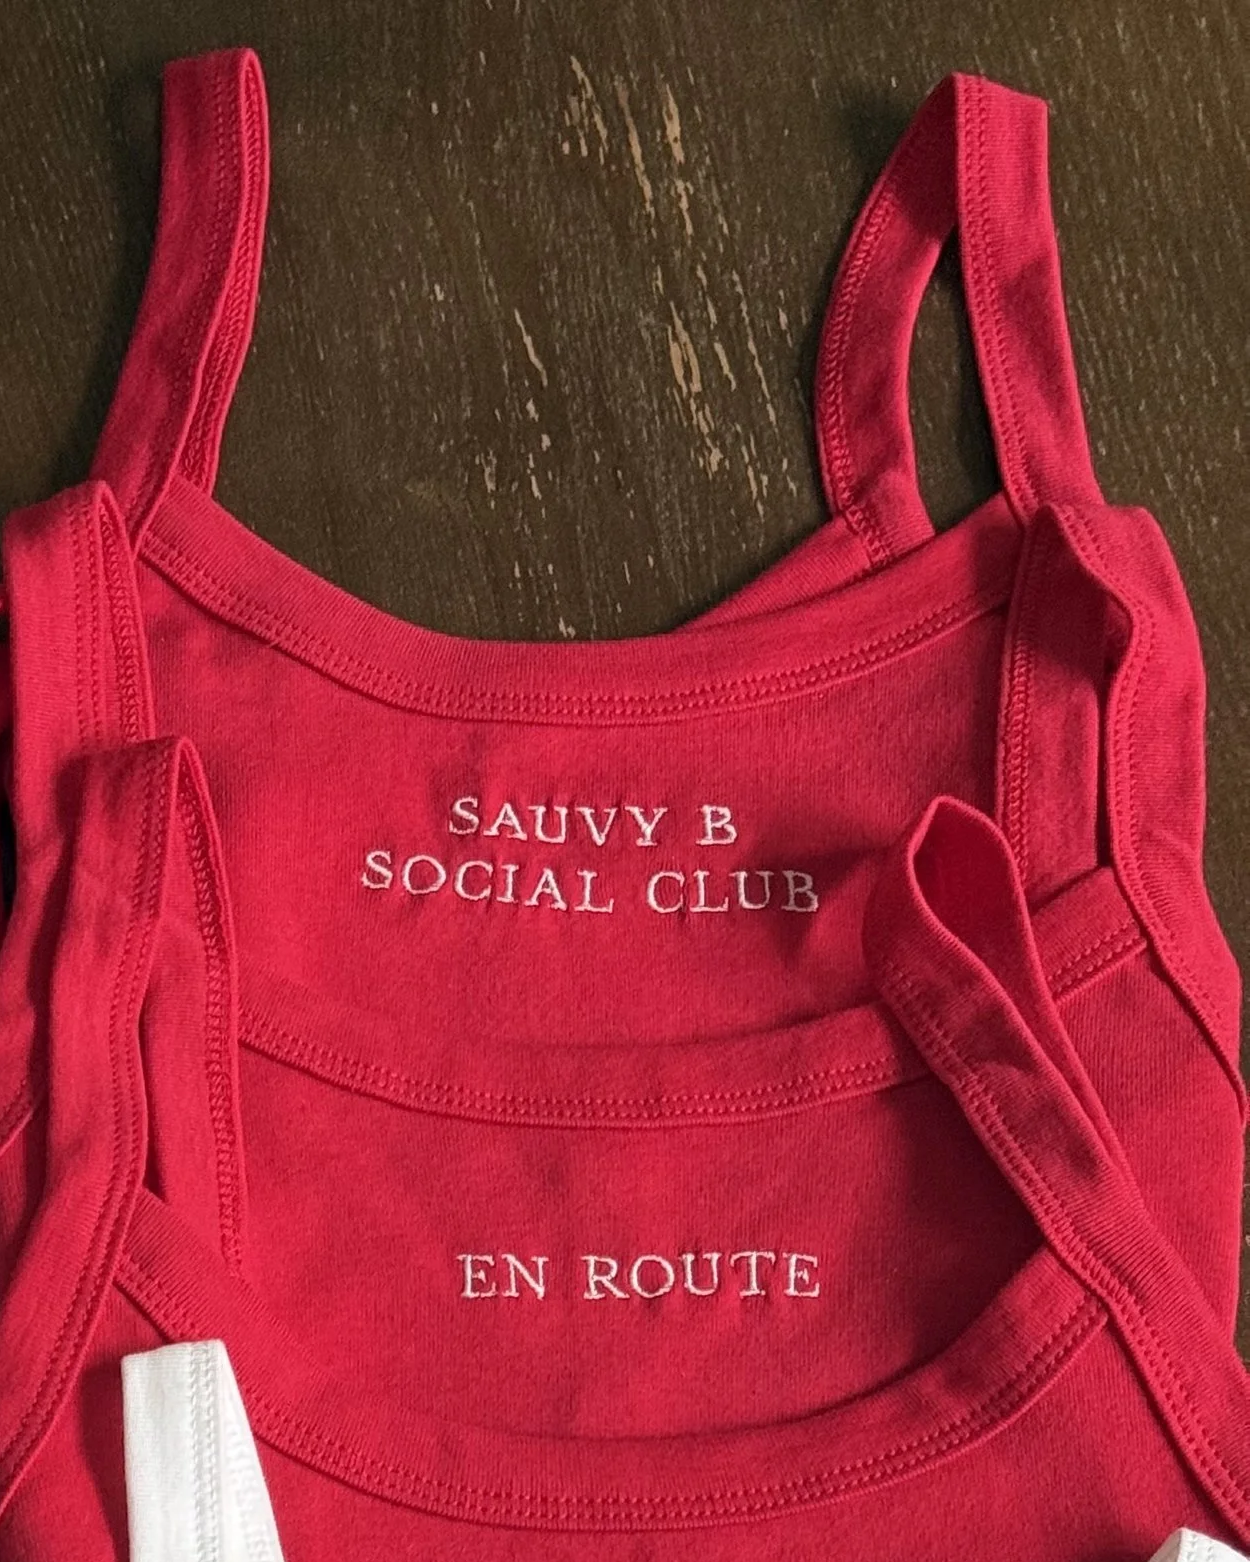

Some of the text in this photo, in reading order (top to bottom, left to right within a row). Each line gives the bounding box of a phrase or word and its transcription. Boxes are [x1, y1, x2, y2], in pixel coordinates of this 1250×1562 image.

[448, 796, 739, 847] SAUVY B
[360, 850, 822, 916] SOCIAL CLUB
[456, 1250, 823, 1301] EN ROUTE
